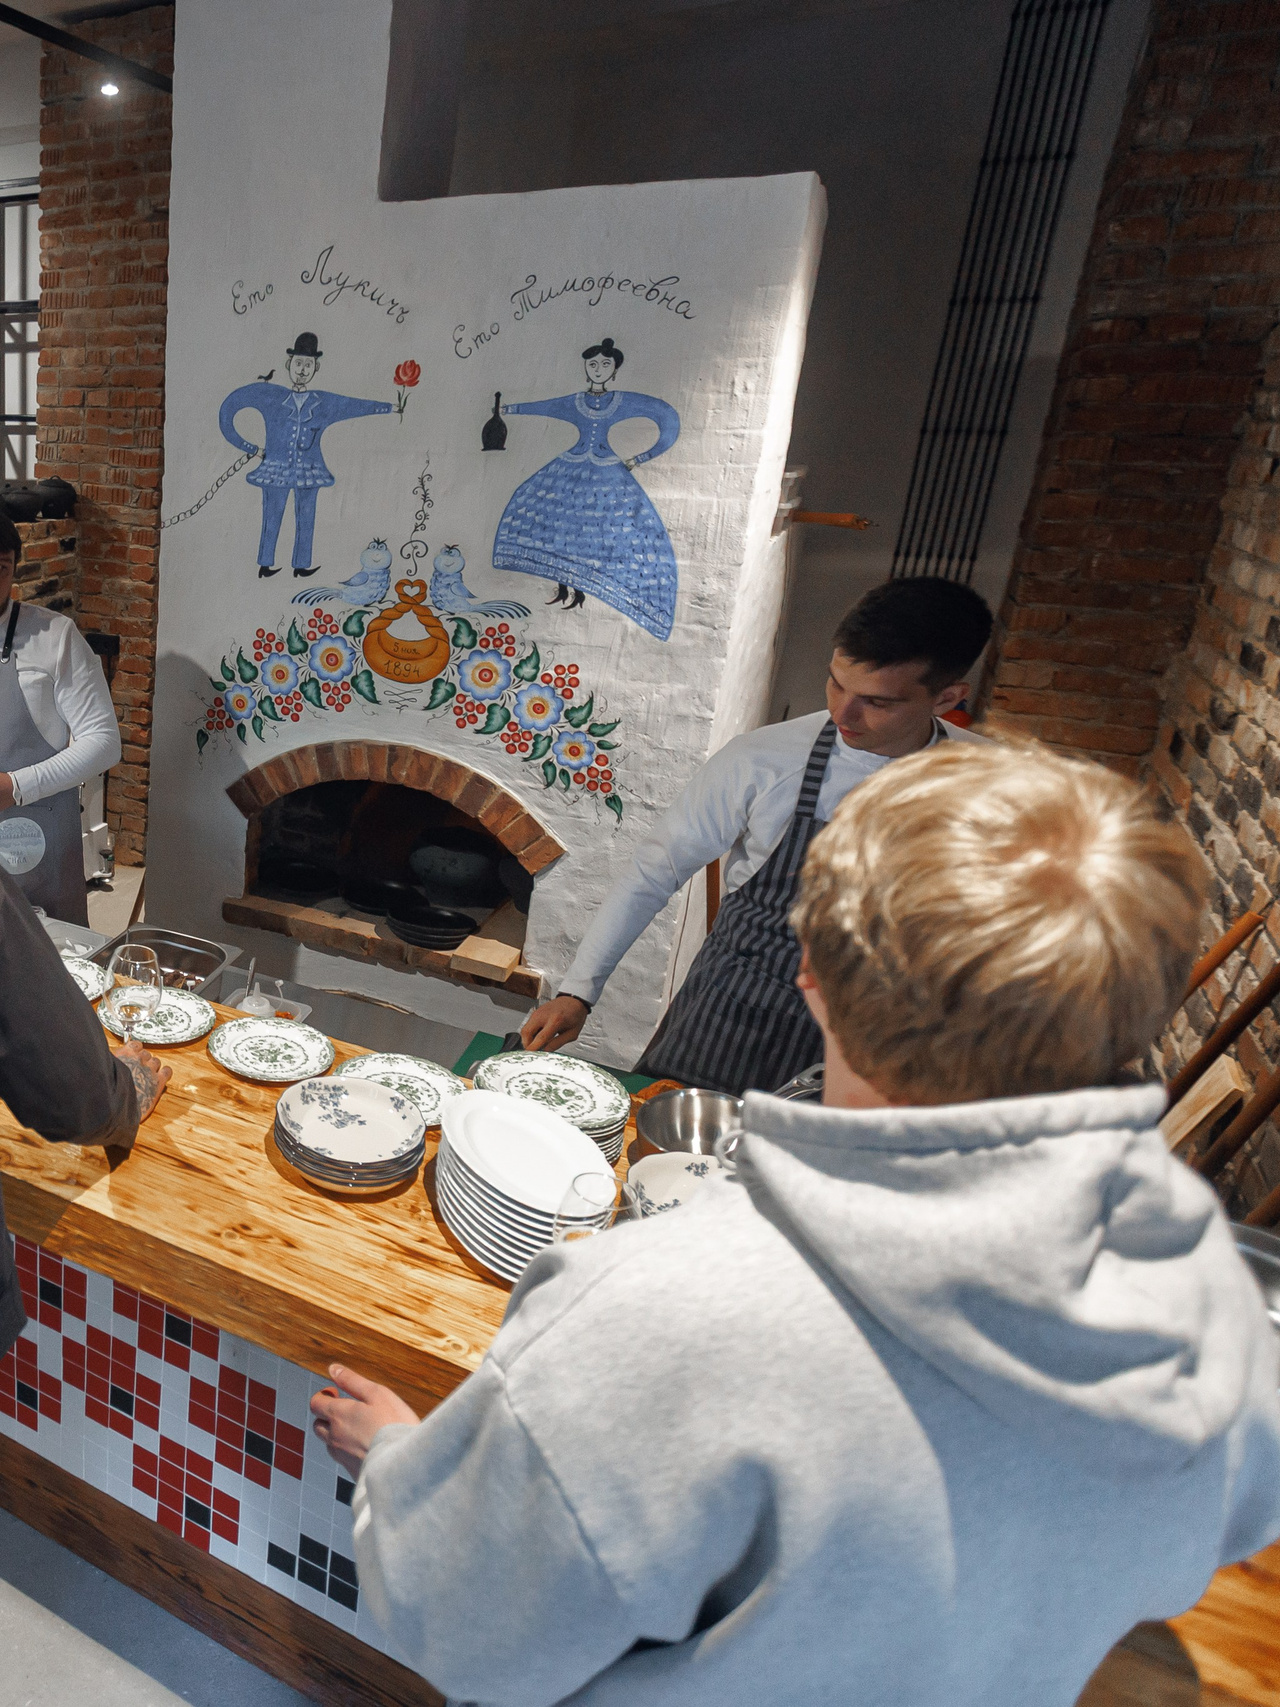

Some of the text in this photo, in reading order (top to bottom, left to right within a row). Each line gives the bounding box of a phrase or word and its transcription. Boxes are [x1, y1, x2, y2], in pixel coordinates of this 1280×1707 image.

[231, 279, 274, 315] Ето
[452, 271, 697, 359] Ето Тимофеевна
[393, 641, 400, 653] 5
[383, 659, 420, 678] 1894
